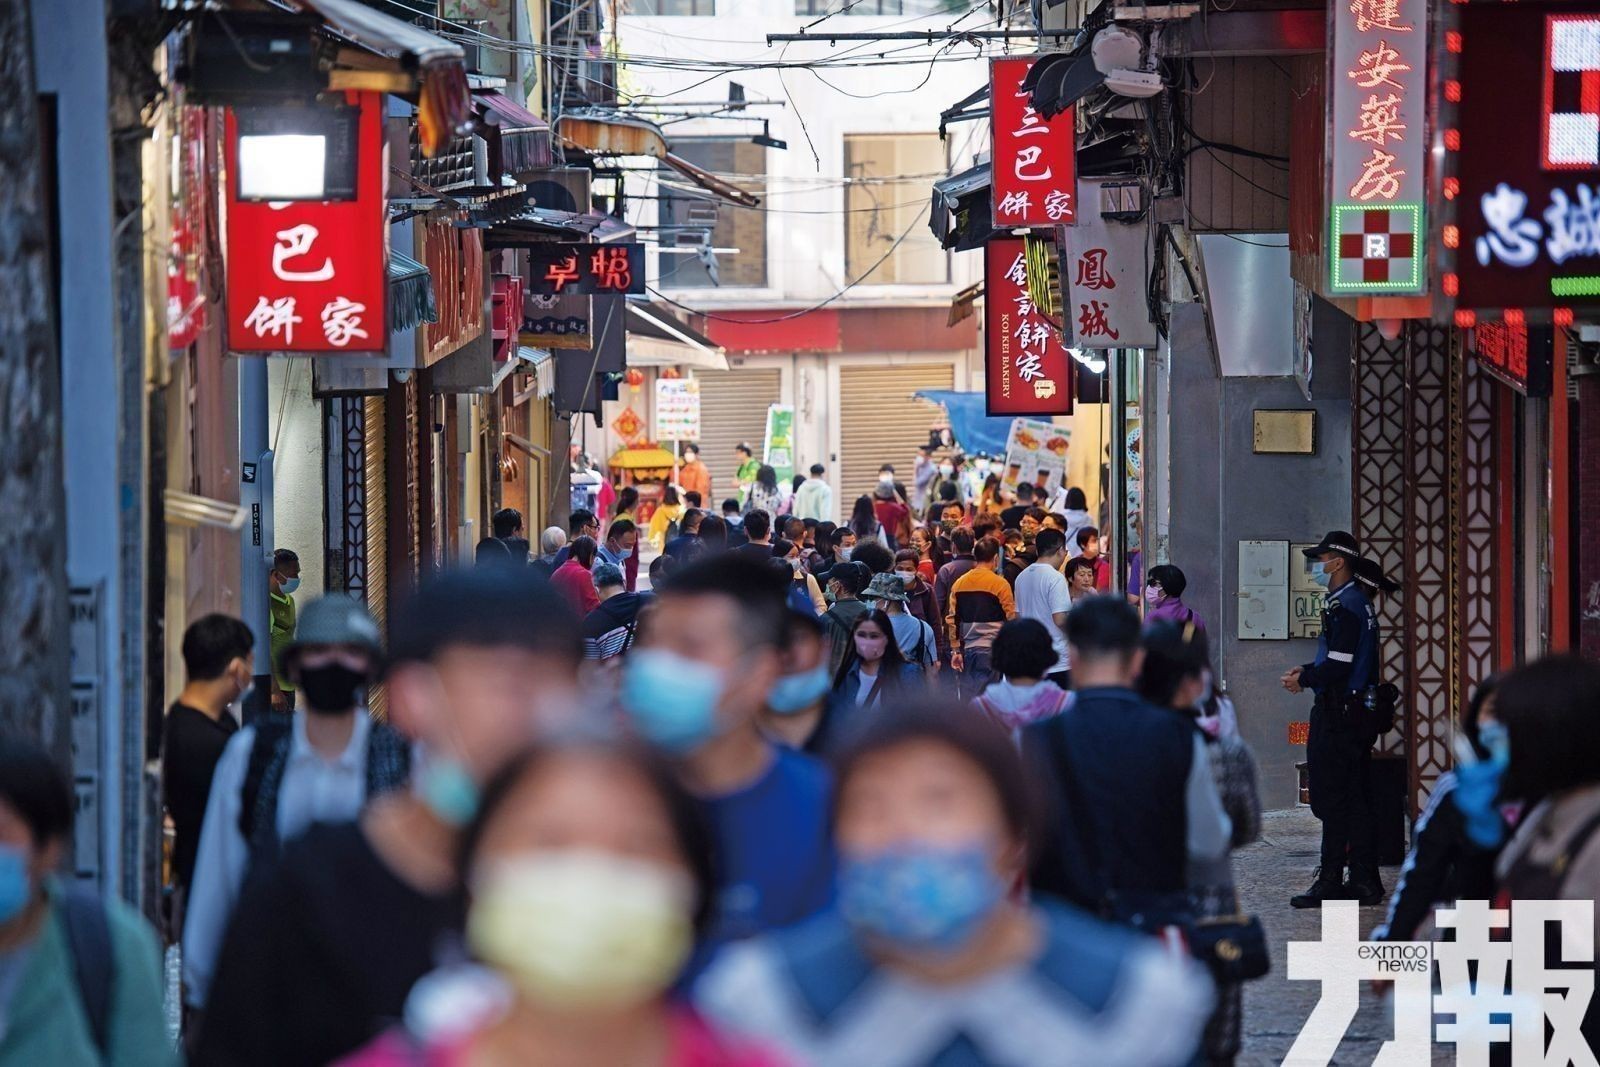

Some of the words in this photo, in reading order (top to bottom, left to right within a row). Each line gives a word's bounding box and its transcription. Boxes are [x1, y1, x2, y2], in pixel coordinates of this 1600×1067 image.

[998, 189, 1073, 221] 餅家
[1075, 248, 1120, 340] 鳳城
[243, 295, 369, 346] 餅家
[1001, 313, 1009, 334] KOI
[1002, 356, 1010, 399] BAKERY
